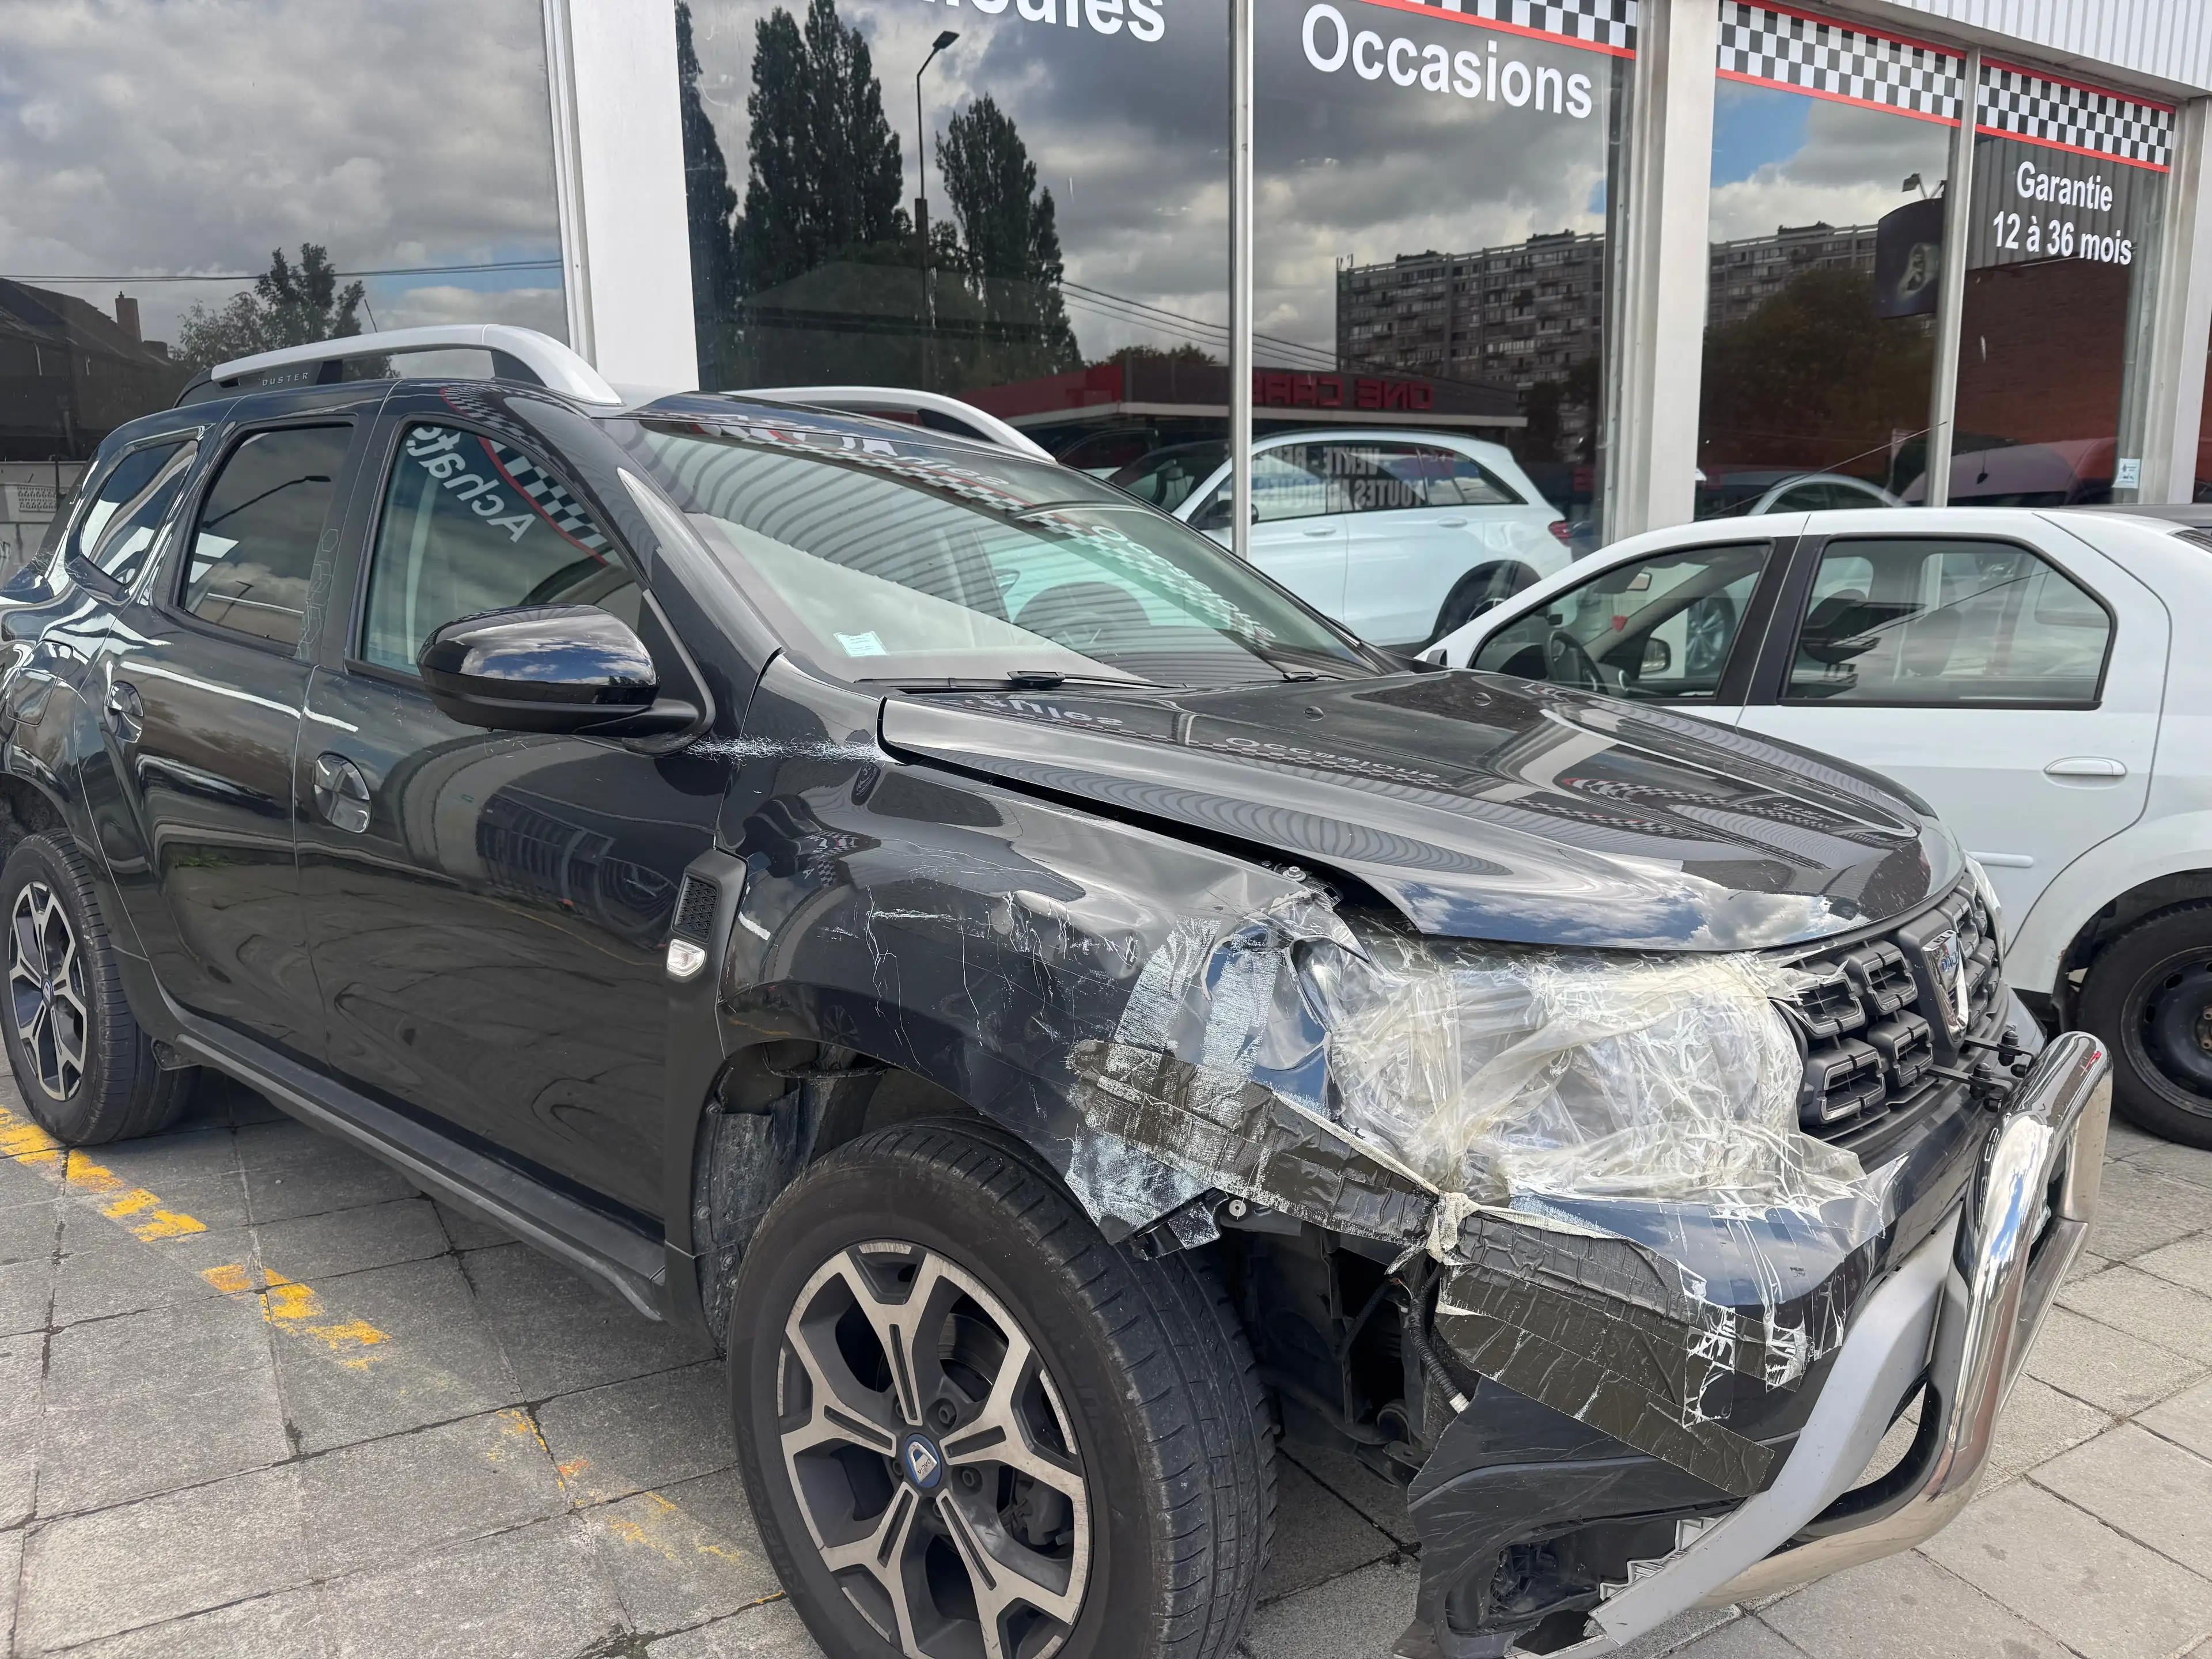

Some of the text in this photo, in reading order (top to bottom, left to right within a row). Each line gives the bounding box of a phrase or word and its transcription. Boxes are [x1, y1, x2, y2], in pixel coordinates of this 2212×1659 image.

[1302, 3, 1592, 119] Occasions
[2016, 161, 2113, 213] Garantie
[1993, 211, 2132, 265] 12 à 36 mois
[262, 373, 309, 386] DUSTER
[917, 1458, 931, 1475] DACIA
